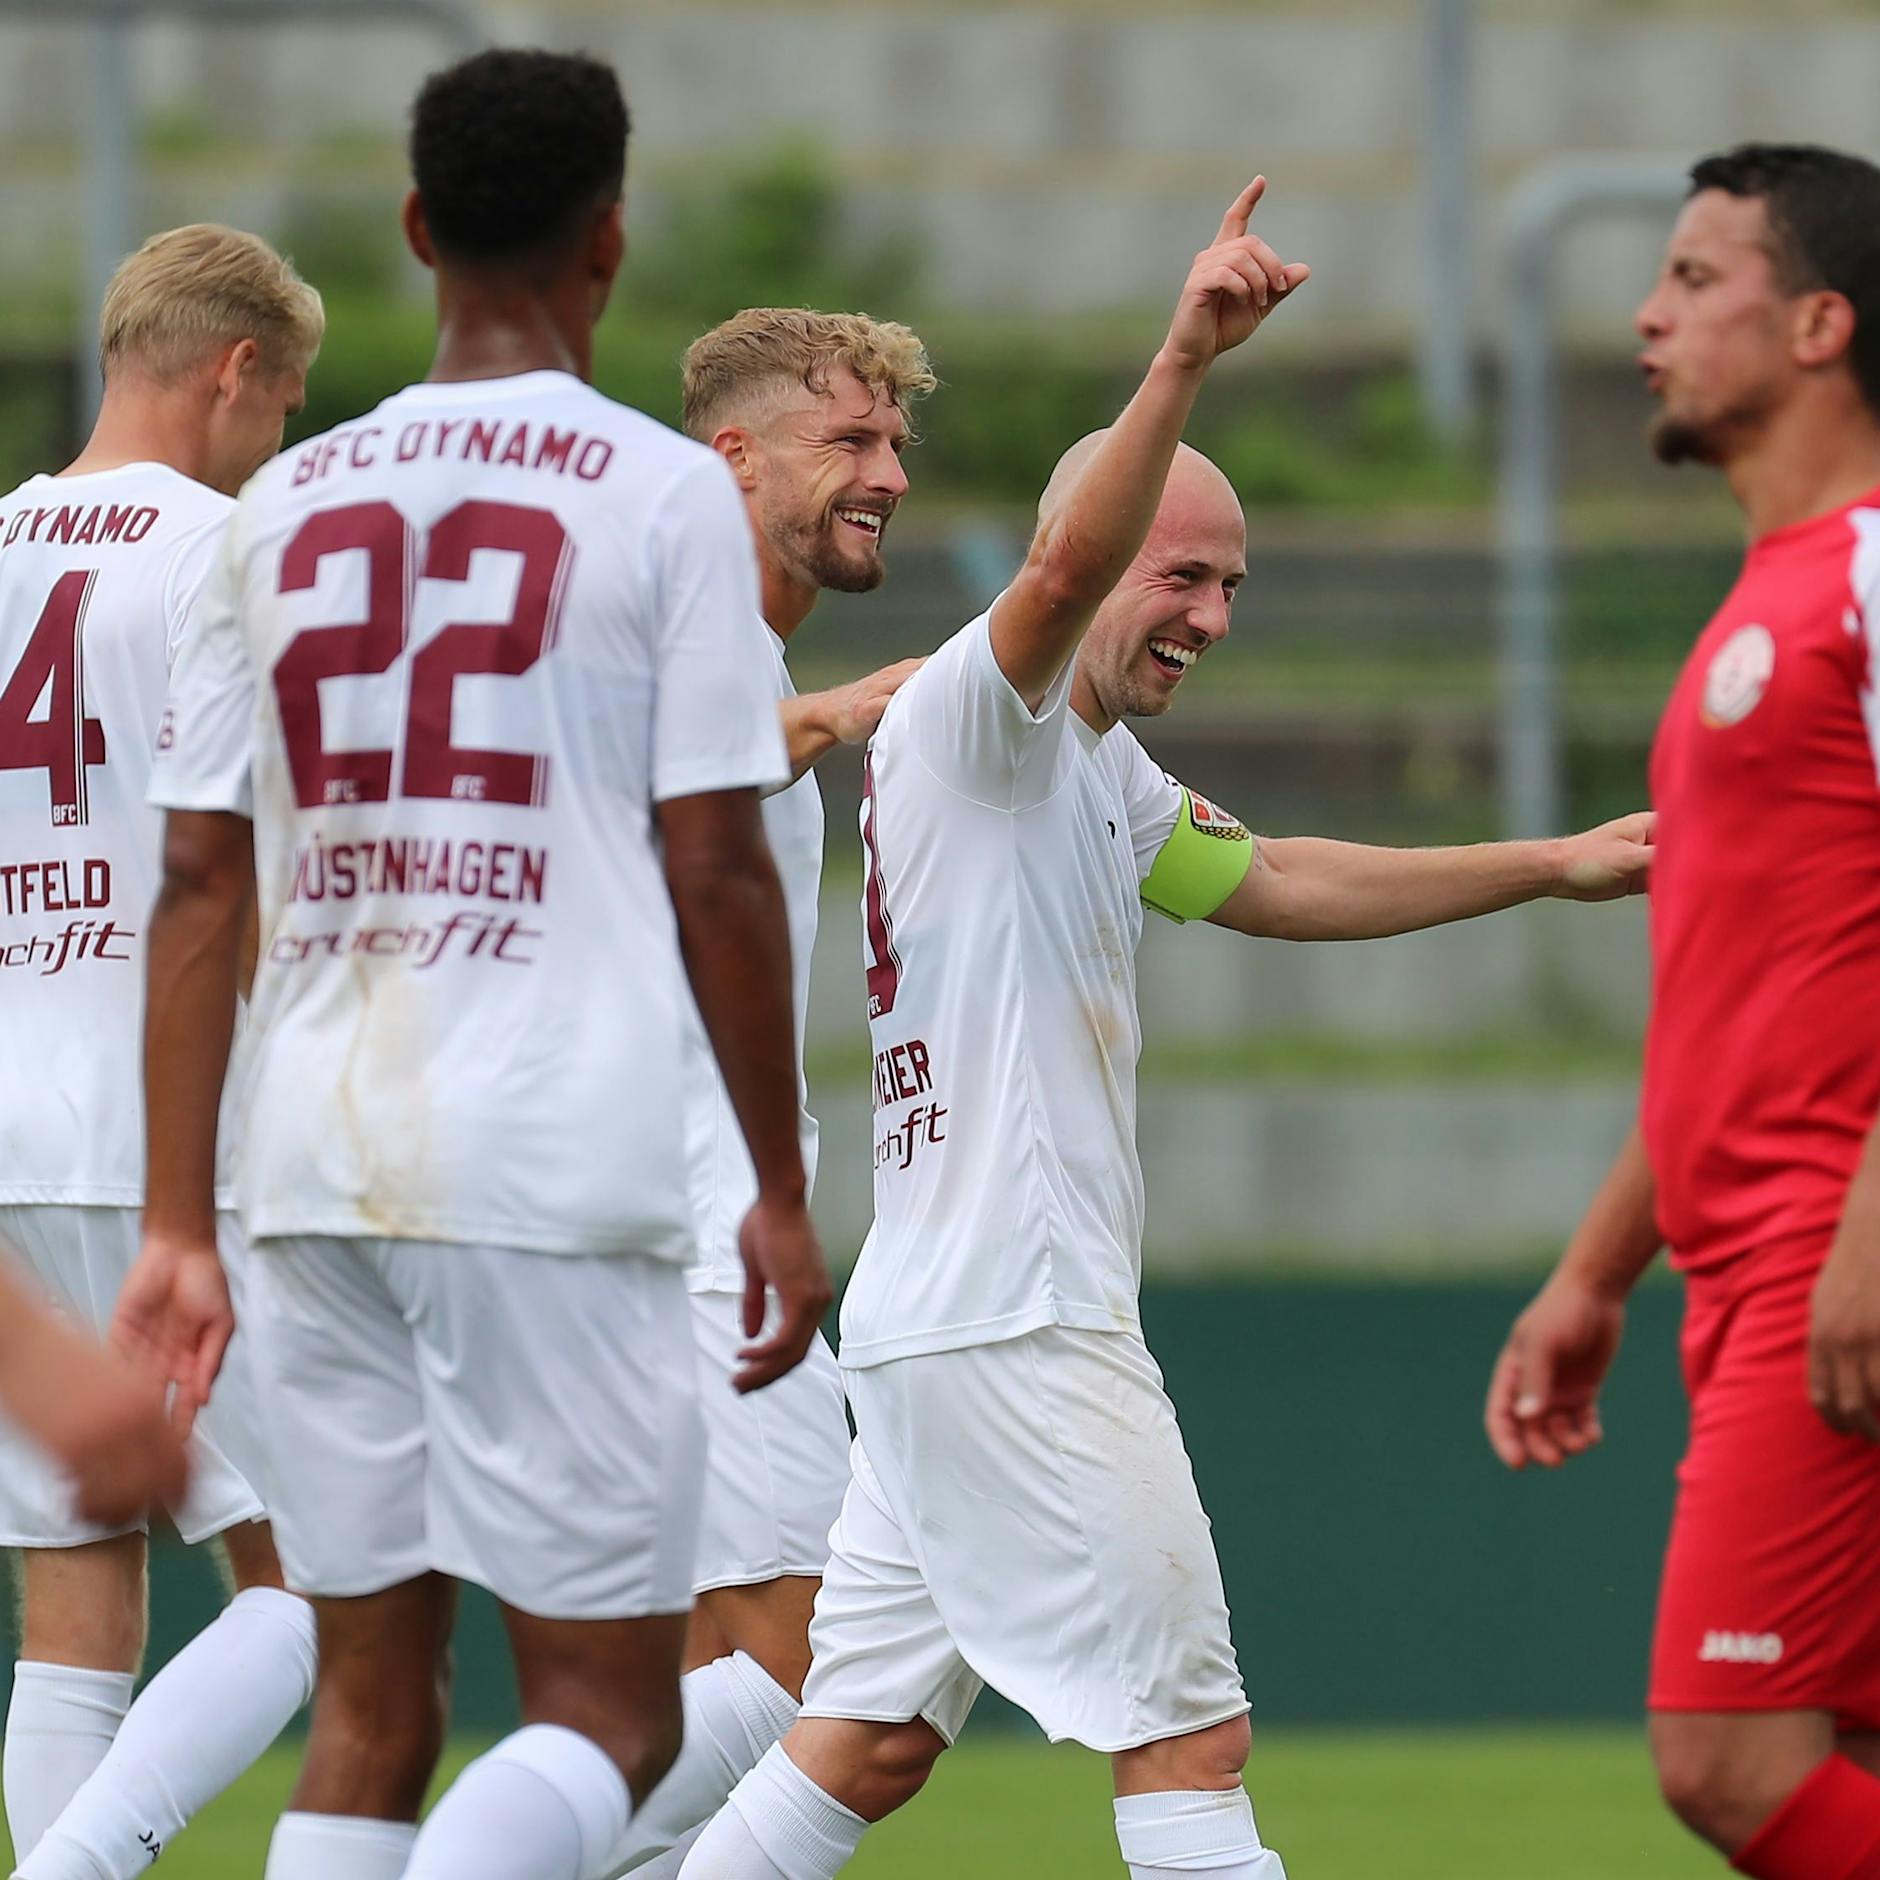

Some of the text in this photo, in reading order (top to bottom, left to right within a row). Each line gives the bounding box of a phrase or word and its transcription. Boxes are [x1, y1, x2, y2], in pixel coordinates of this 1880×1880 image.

[291, 420, 615, 488] BFC DYNAMO
[3, 504, 160, 548] DYNAMO
[272, 498, 577, 809] 22
[0, 568, 106, 825] 4
[53, 804, 77, 824] BFC
[0, 859, 110, 915] TFELD
[288, 831, 546, 904] ÜSTNHAGEN
